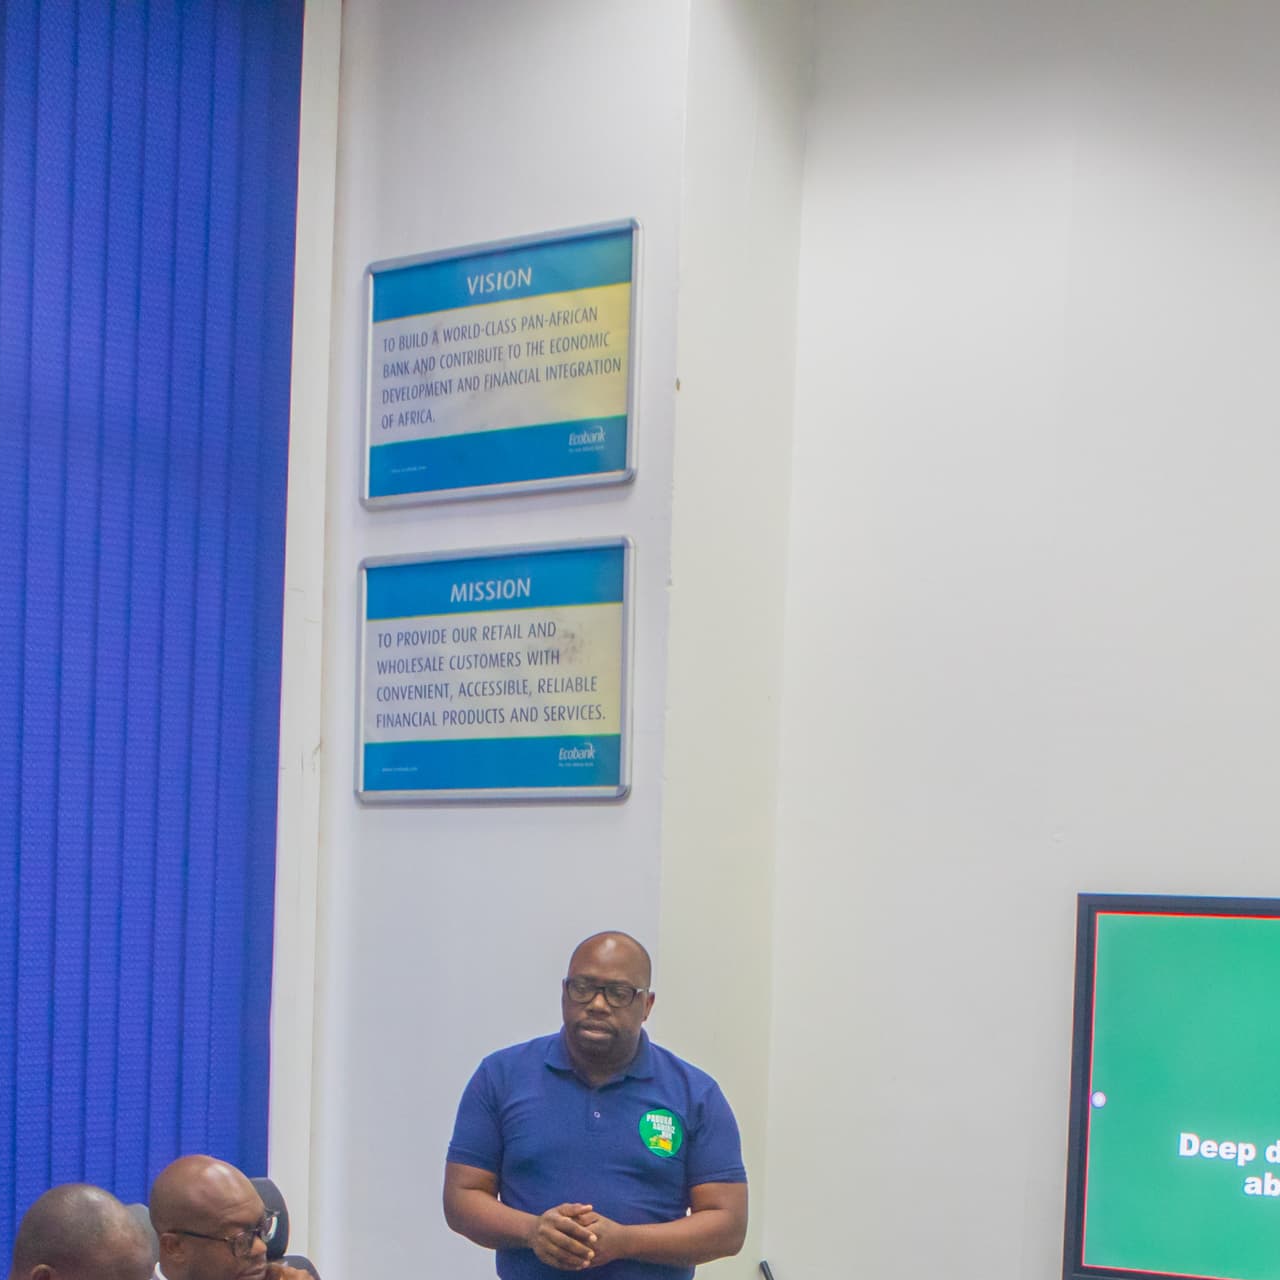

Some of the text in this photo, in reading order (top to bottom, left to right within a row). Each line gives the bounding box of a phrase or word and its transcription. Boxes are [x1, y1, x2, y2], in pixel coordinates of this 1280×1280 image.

[466, 268, 532, 295] VISION
[383, 306, 598, 353] TO BUILD A WORLD-CLASS PAN-AFRICAN
[382, 332, 610, 378] BANK AND CONTRIBUTE TO THE ECONOMIC
[382, 358, 622, 404] DEVELOPMENT AND FINANCIAL INTEGRATION
[381, 409, 436, 430] OF AFRICA.
[450, 578, 531, 602] MISSION
[378, 622, 556, 648] TO PROVIDE OUR RETAIL AND
[376, 650, 560, 676] WHOLESALE CUSTOMERS WITH
[376, 676, 598, 702] CONVENIENT, ACCESSIBLE, RELIABLE
[376, 704, 606, 728] FINANCIAL PRODUCTS AND SERVICES.
[558, 742, 595, 761] Ecobank
[1178, 1133, 1257, 1166] Deep
